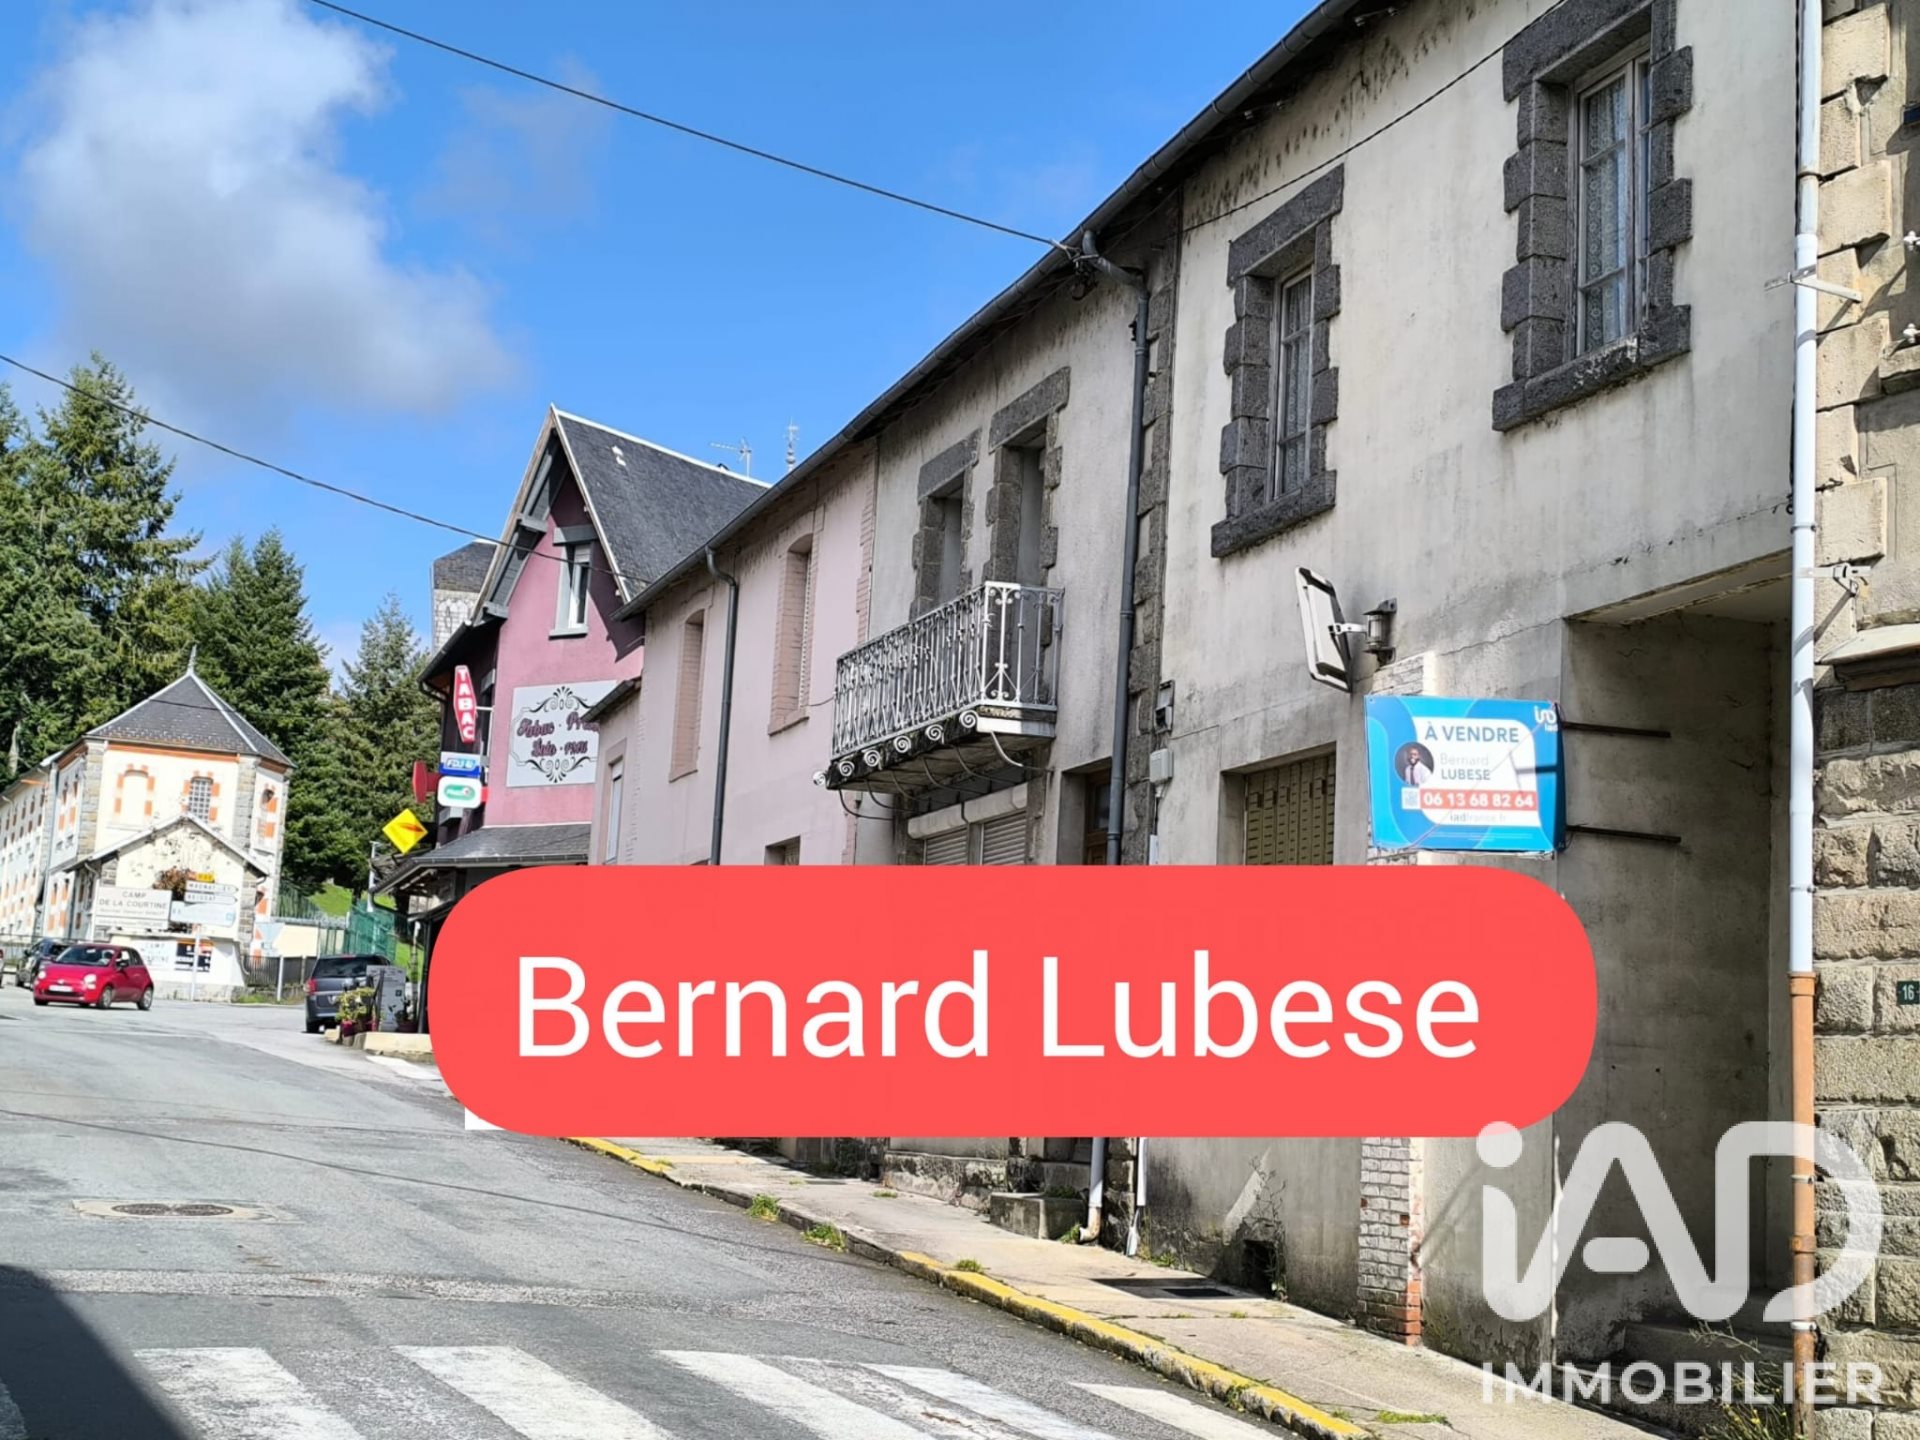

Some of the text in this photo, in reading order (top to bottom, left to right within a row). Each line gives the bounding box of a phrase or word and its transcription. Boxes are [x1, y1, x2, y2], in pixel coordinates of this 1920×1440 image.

[457, 667, 474, 738] TABAC
[517, 718, 555, 738] Tabac
[1424, 720, 1520, 743] À VENDRE
[1440, 752, 1489, 767] Bernard
[1441, 768, 1491, 781] LUBESE
[1423, 792, 1535, 808] 06 13 68 82 64
[122, 890, 147, 899] CAMP
[99, 899, 110, 907] DE
[127, 901, 168, 909] COURTINE
[1902, 984, 1915, 1000] 16
